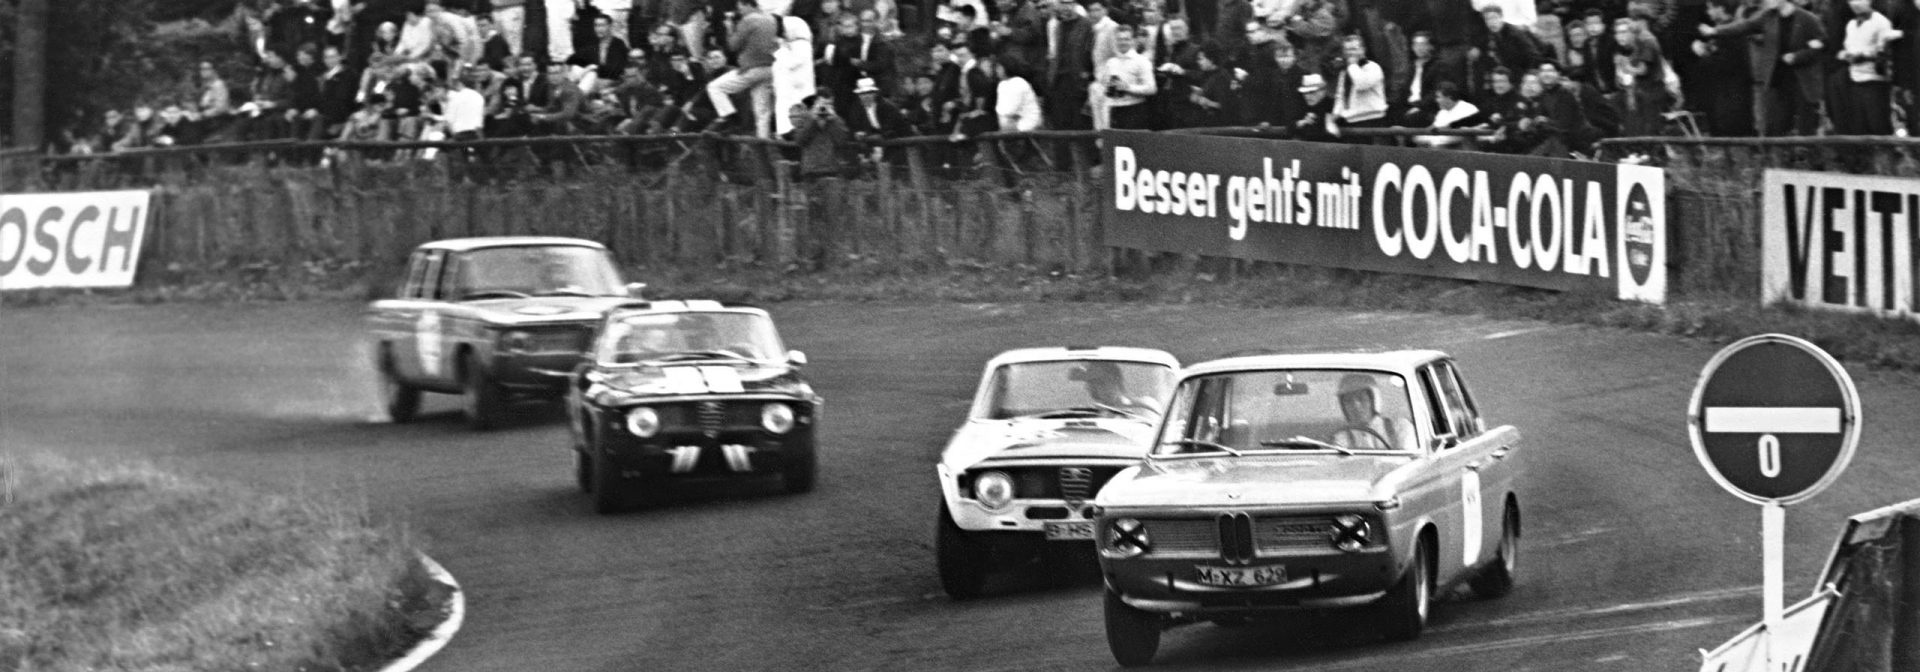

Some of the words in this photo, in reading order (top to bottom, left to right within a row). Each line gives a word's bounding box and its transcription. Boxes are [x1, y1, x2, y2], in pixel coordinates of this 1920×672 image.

[1114, 146, 1220, 217] Besser
[1227, 156, 1312, 241] geht's
[1316, 166, 1362, 230] mit
[1373, 162, 1610, 279] COCA-COLA
